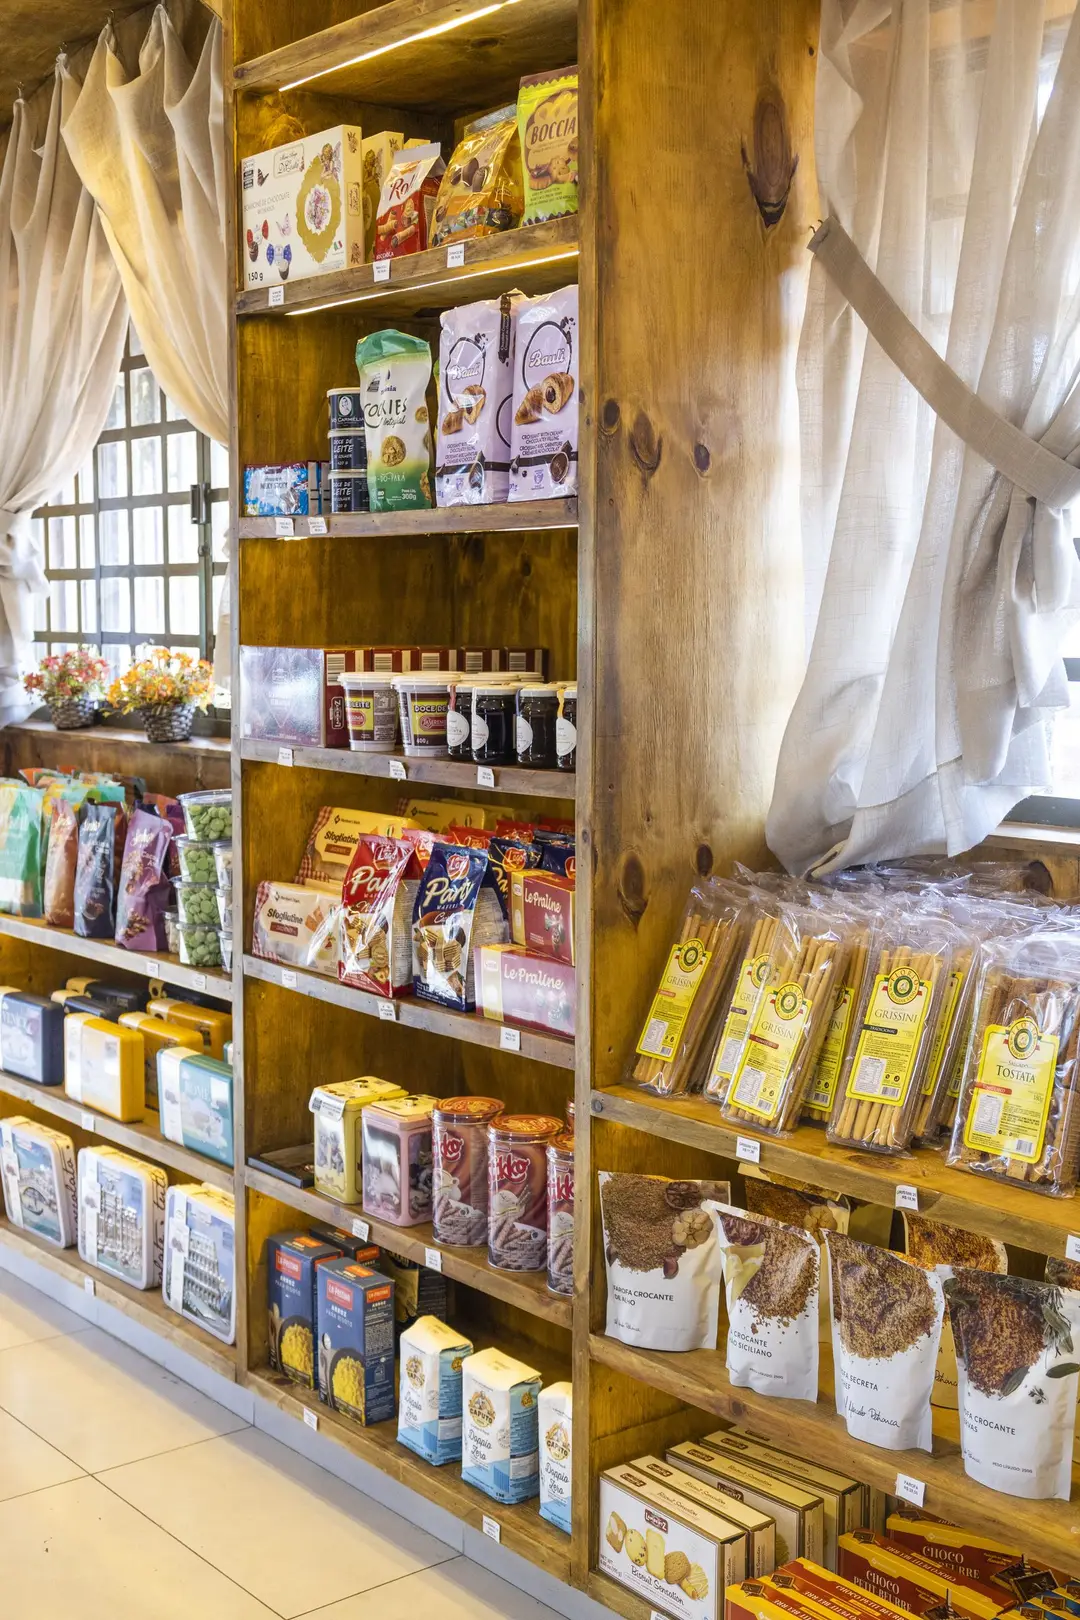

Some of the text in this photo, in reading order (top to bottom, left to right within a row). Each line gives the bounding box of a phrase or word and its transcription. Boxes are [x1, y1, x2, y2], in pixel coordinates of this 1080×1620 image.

[248, 272, 258, 281] 150
[528, 348, 566, 368] Bauli
[333, 444, 354, 453] LEITE
[332, 487, 352, 496] LEITE
[401, 493, 416, 501] 300g
[423, 878, 475, 906] Party
[533, 893, 562, 914] Praline
[266, 908, 304, 925] Sfogliatine
[504, 964, 564, 990] Le Praline
[874, 1009, 918, 1023] GRISSINI
[761, 1020, 797, 1040] GRISSINI
[996, 1065, 1036, 1084] TOSTATA
[633, 1290, 674, 1302] CROCANTE
[734, 1330, 768, 1348] CROCANTE
[738, 1342, 773, 1358] SICILIANO
[850, 1374, 879, 1392] SECRETA
[469, 1408, 493, 1424] CAPUTO
[974, 1415, 1016, 1436] CROCANTE
[468, 1429, 493, 1450] Doppio
[546, 1440, 569, 1457] CAPUTO
[471, 1445, 487, 1461] Zero
[545, 1463, 569, 1484] Doppio
[549, 1480, 564, 1495] Zero
[904, 1480, 919, 1490] FAROFA
[923, 1545, 964, 1564] CHOCO
[631, 1564, 685, 1606] Biscuit Sensation
[866, 1570, 900, 1595] CHOCO
[835, 1585, 860, 1600] CHOCO
[859, 1597, 879, 1611] PETIT
[853, 1576, 912, 1613] PETIT BEURRE
